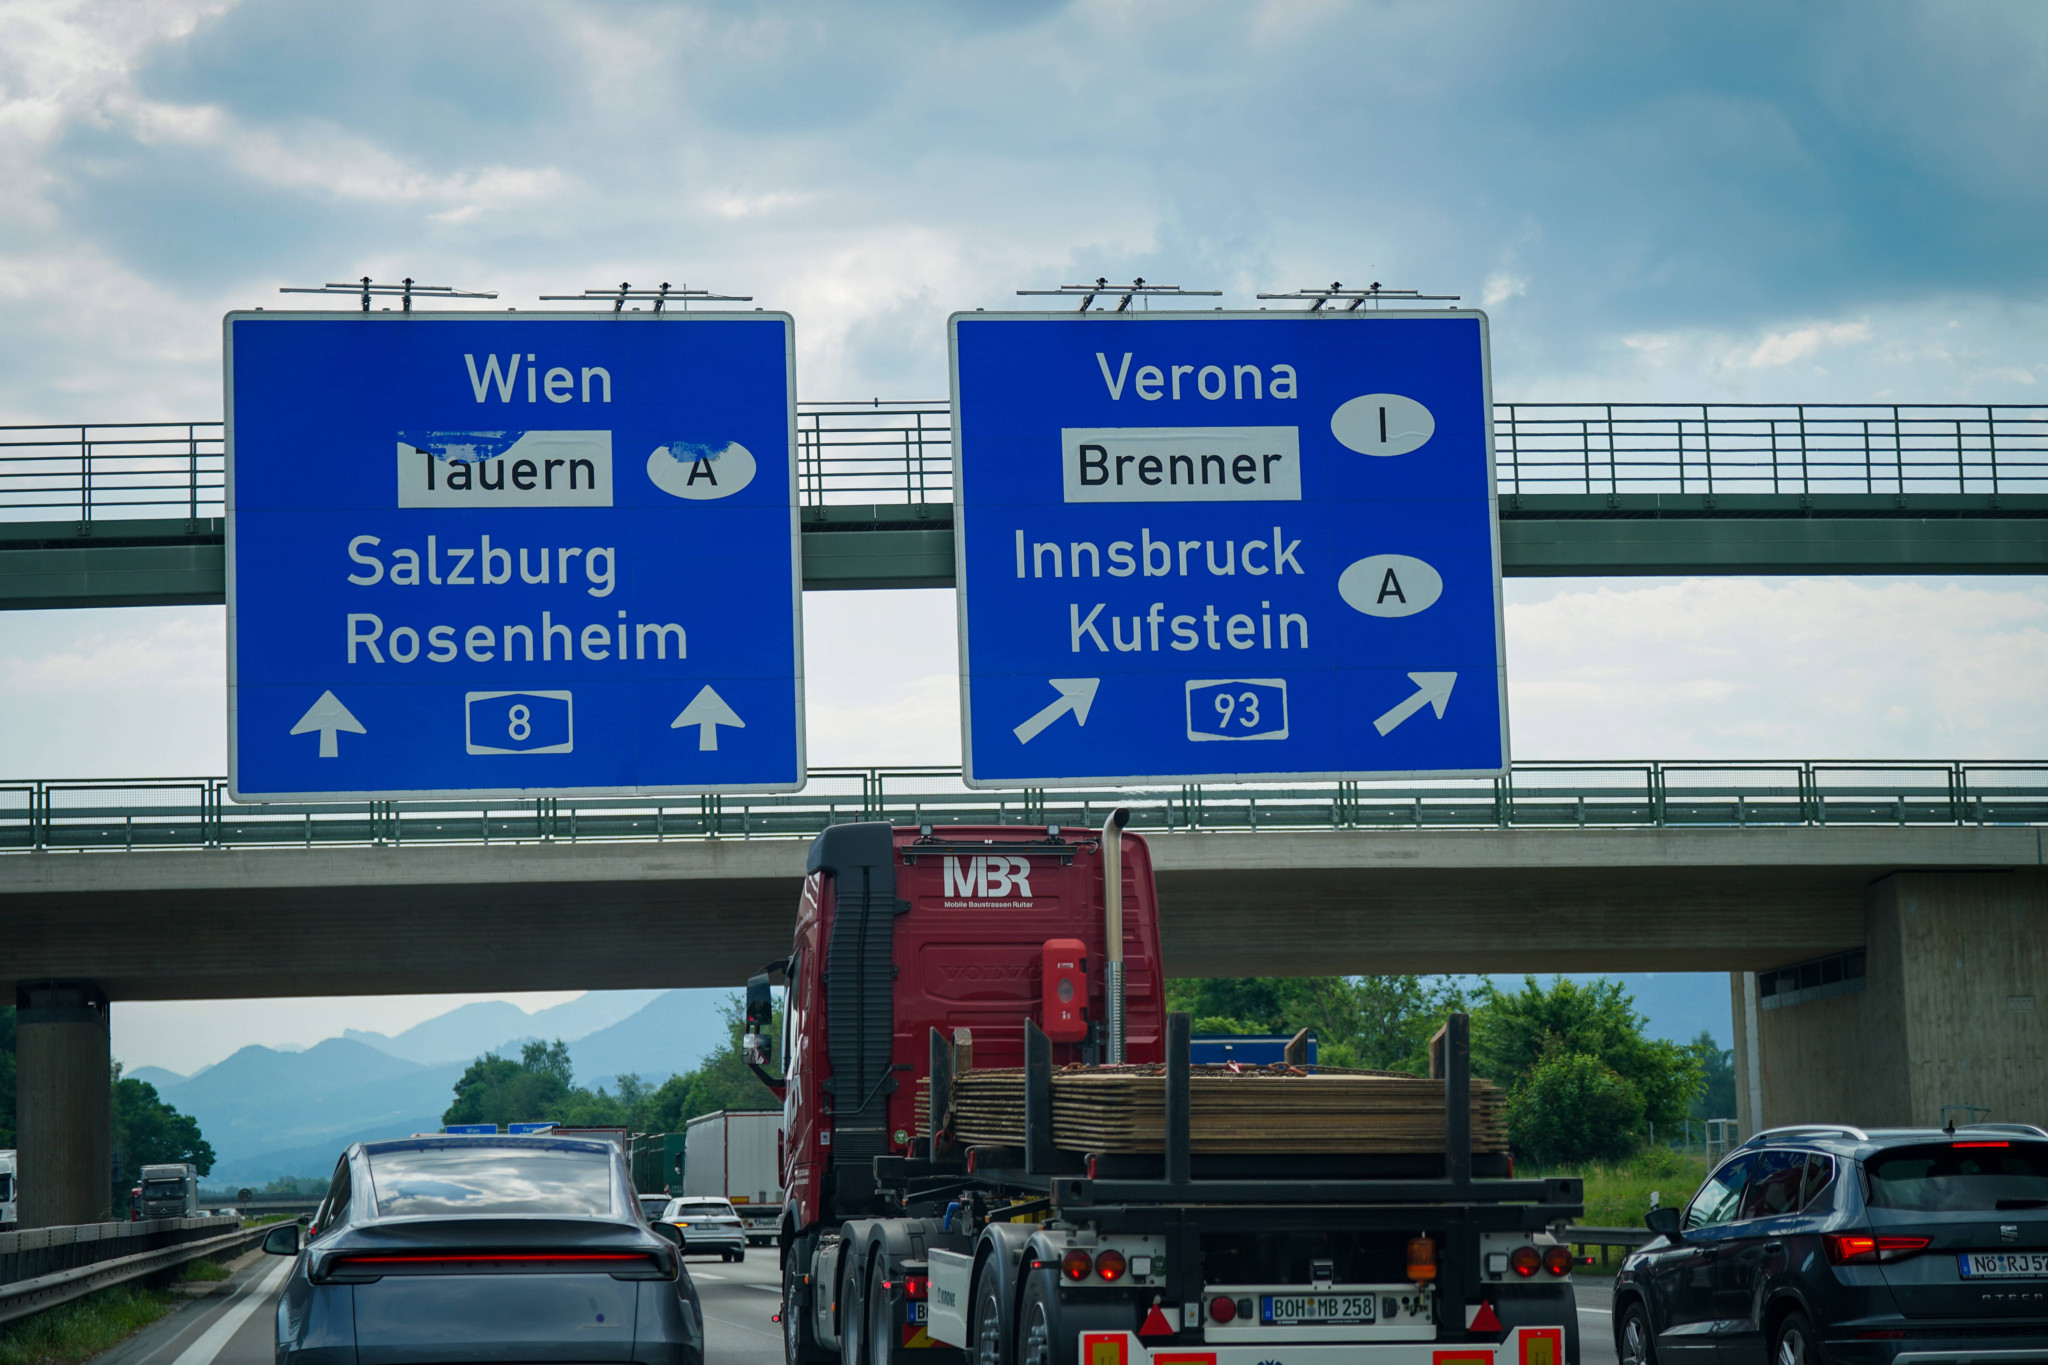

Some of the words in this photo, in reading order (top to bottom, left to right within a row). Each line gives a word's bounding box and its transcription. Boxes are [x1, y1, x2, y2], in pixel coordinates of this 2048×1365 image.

[464, 353, 611, 404] Wien
[1096, 352, 1298, 400] Verona
[1379, 406, 1387, 443] I
[415, 447, 595, 491] Tauern
[686, 457, 719, 487] A
[1079, 444, 1283, 486] Brenner
[347, 534, 616, 598] Salzburg
[1015, 526, 1305, 578] Innsbruck
[1376, 567, 1407, 604] A
[347, 610, 687, 664] Rosenheim
[1070, 600, 1309, 653] Kufstein
[508, 703, 531, 741] 8
[1214, 692, 1260, 729] 93
[943, 856, 1033, 897] MBR
[937, 965, 1043, 982] VOLVO
[1974, 1255, 1997, 1272] NÖ
[2007, 1255, 2030, 1272] RJ
[1274, 1299, 1306, 1318] BOH
[1318, 1298, 1338, 1317] MB
[1342, 1298, 1372, 1317] 258
